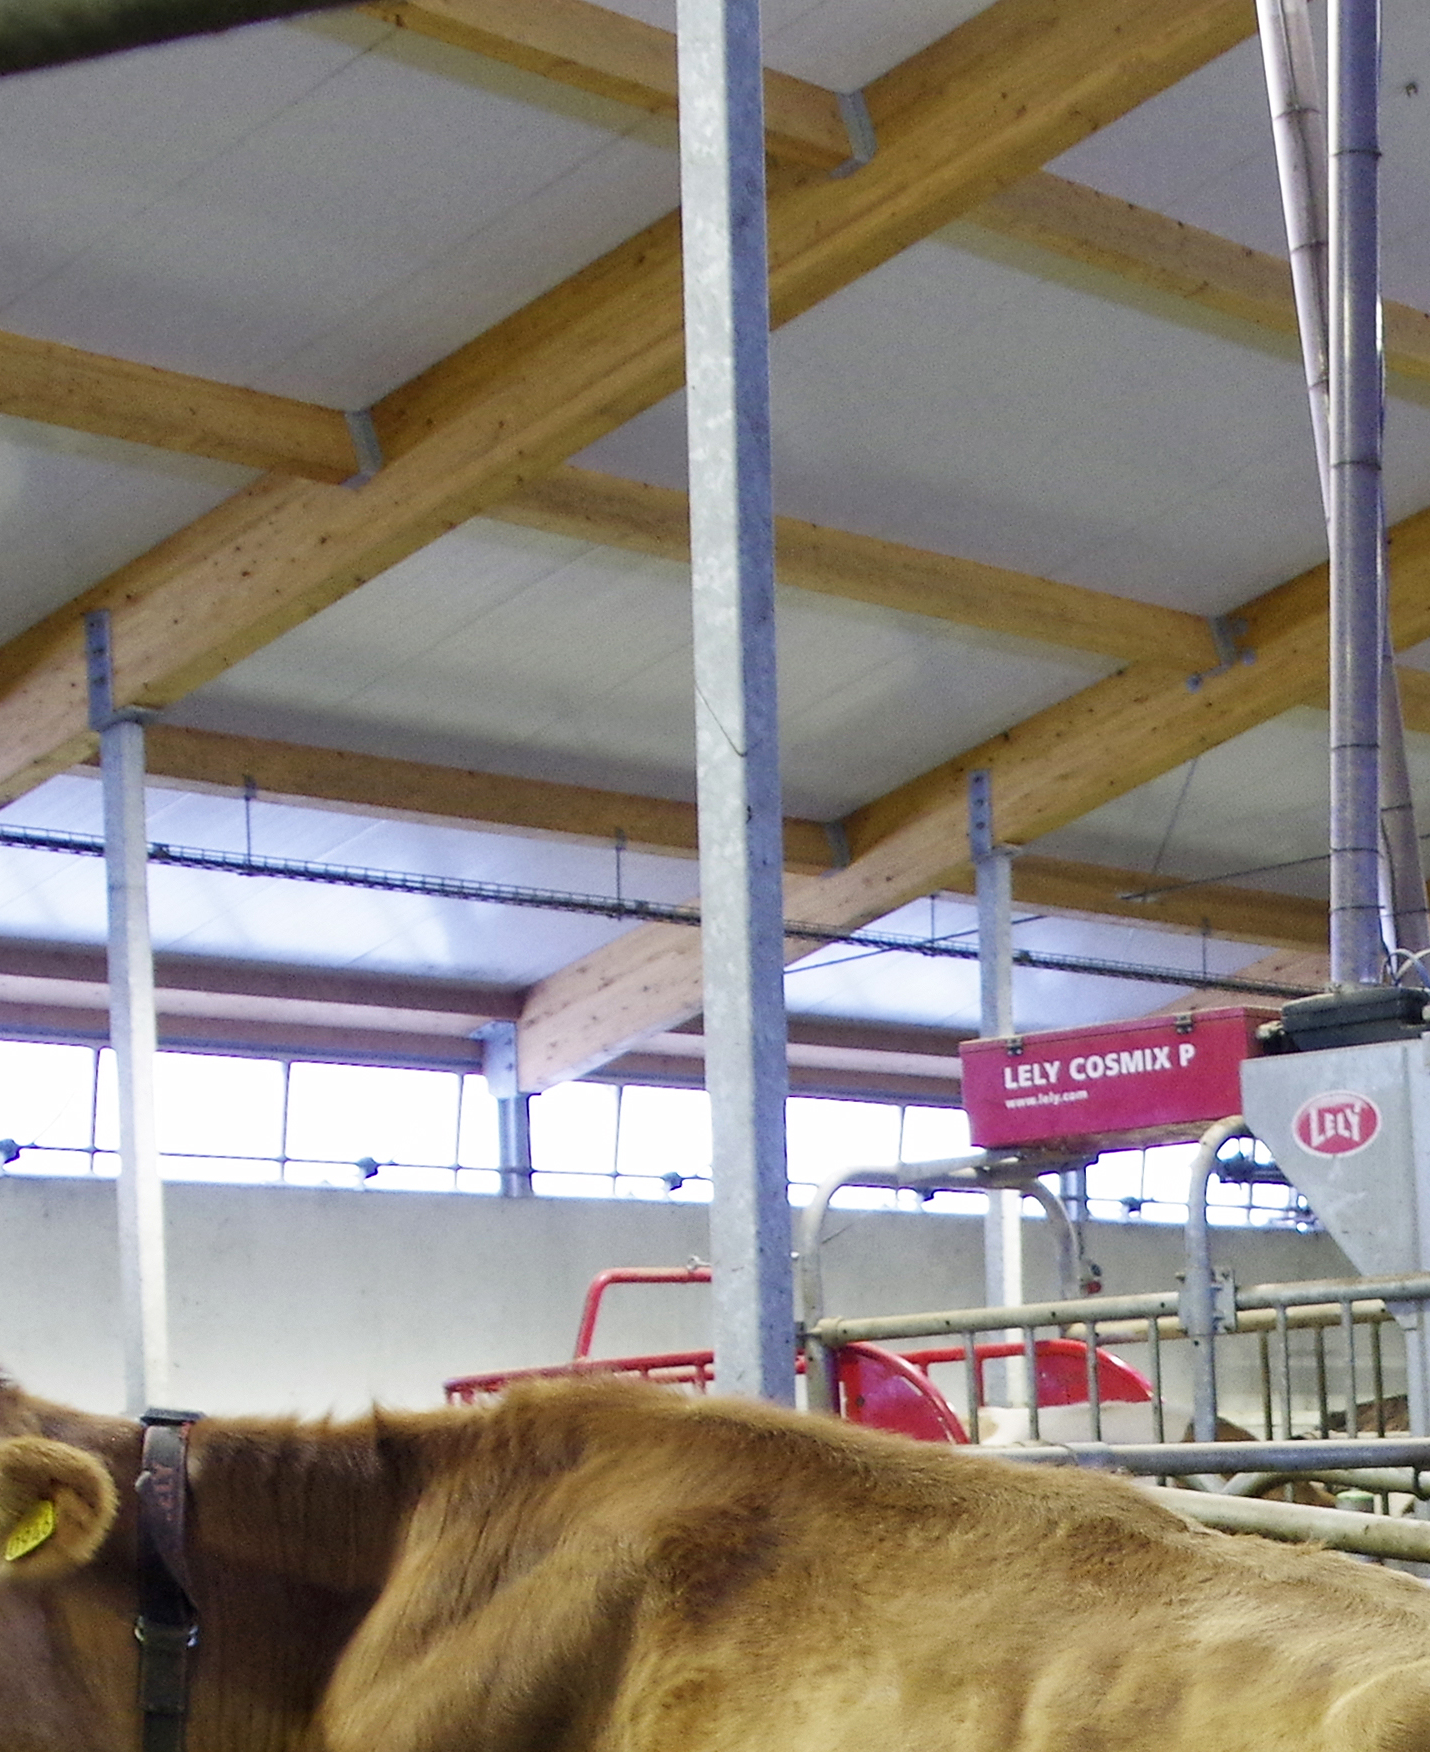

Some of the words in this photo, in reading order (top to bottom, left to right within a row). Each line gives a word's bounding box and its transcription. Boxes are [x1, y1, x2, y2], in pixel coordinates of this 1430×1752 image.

[1004, 1060, 1061, 1089] LELY
[1069, 1047, 1172, 1081] COSMIX
[1178, 1043, 1196, 1067] P
[1005, 1089, 1089, 1109] www.lely.com
[1309, 1101, 1362, 1148] LELY
